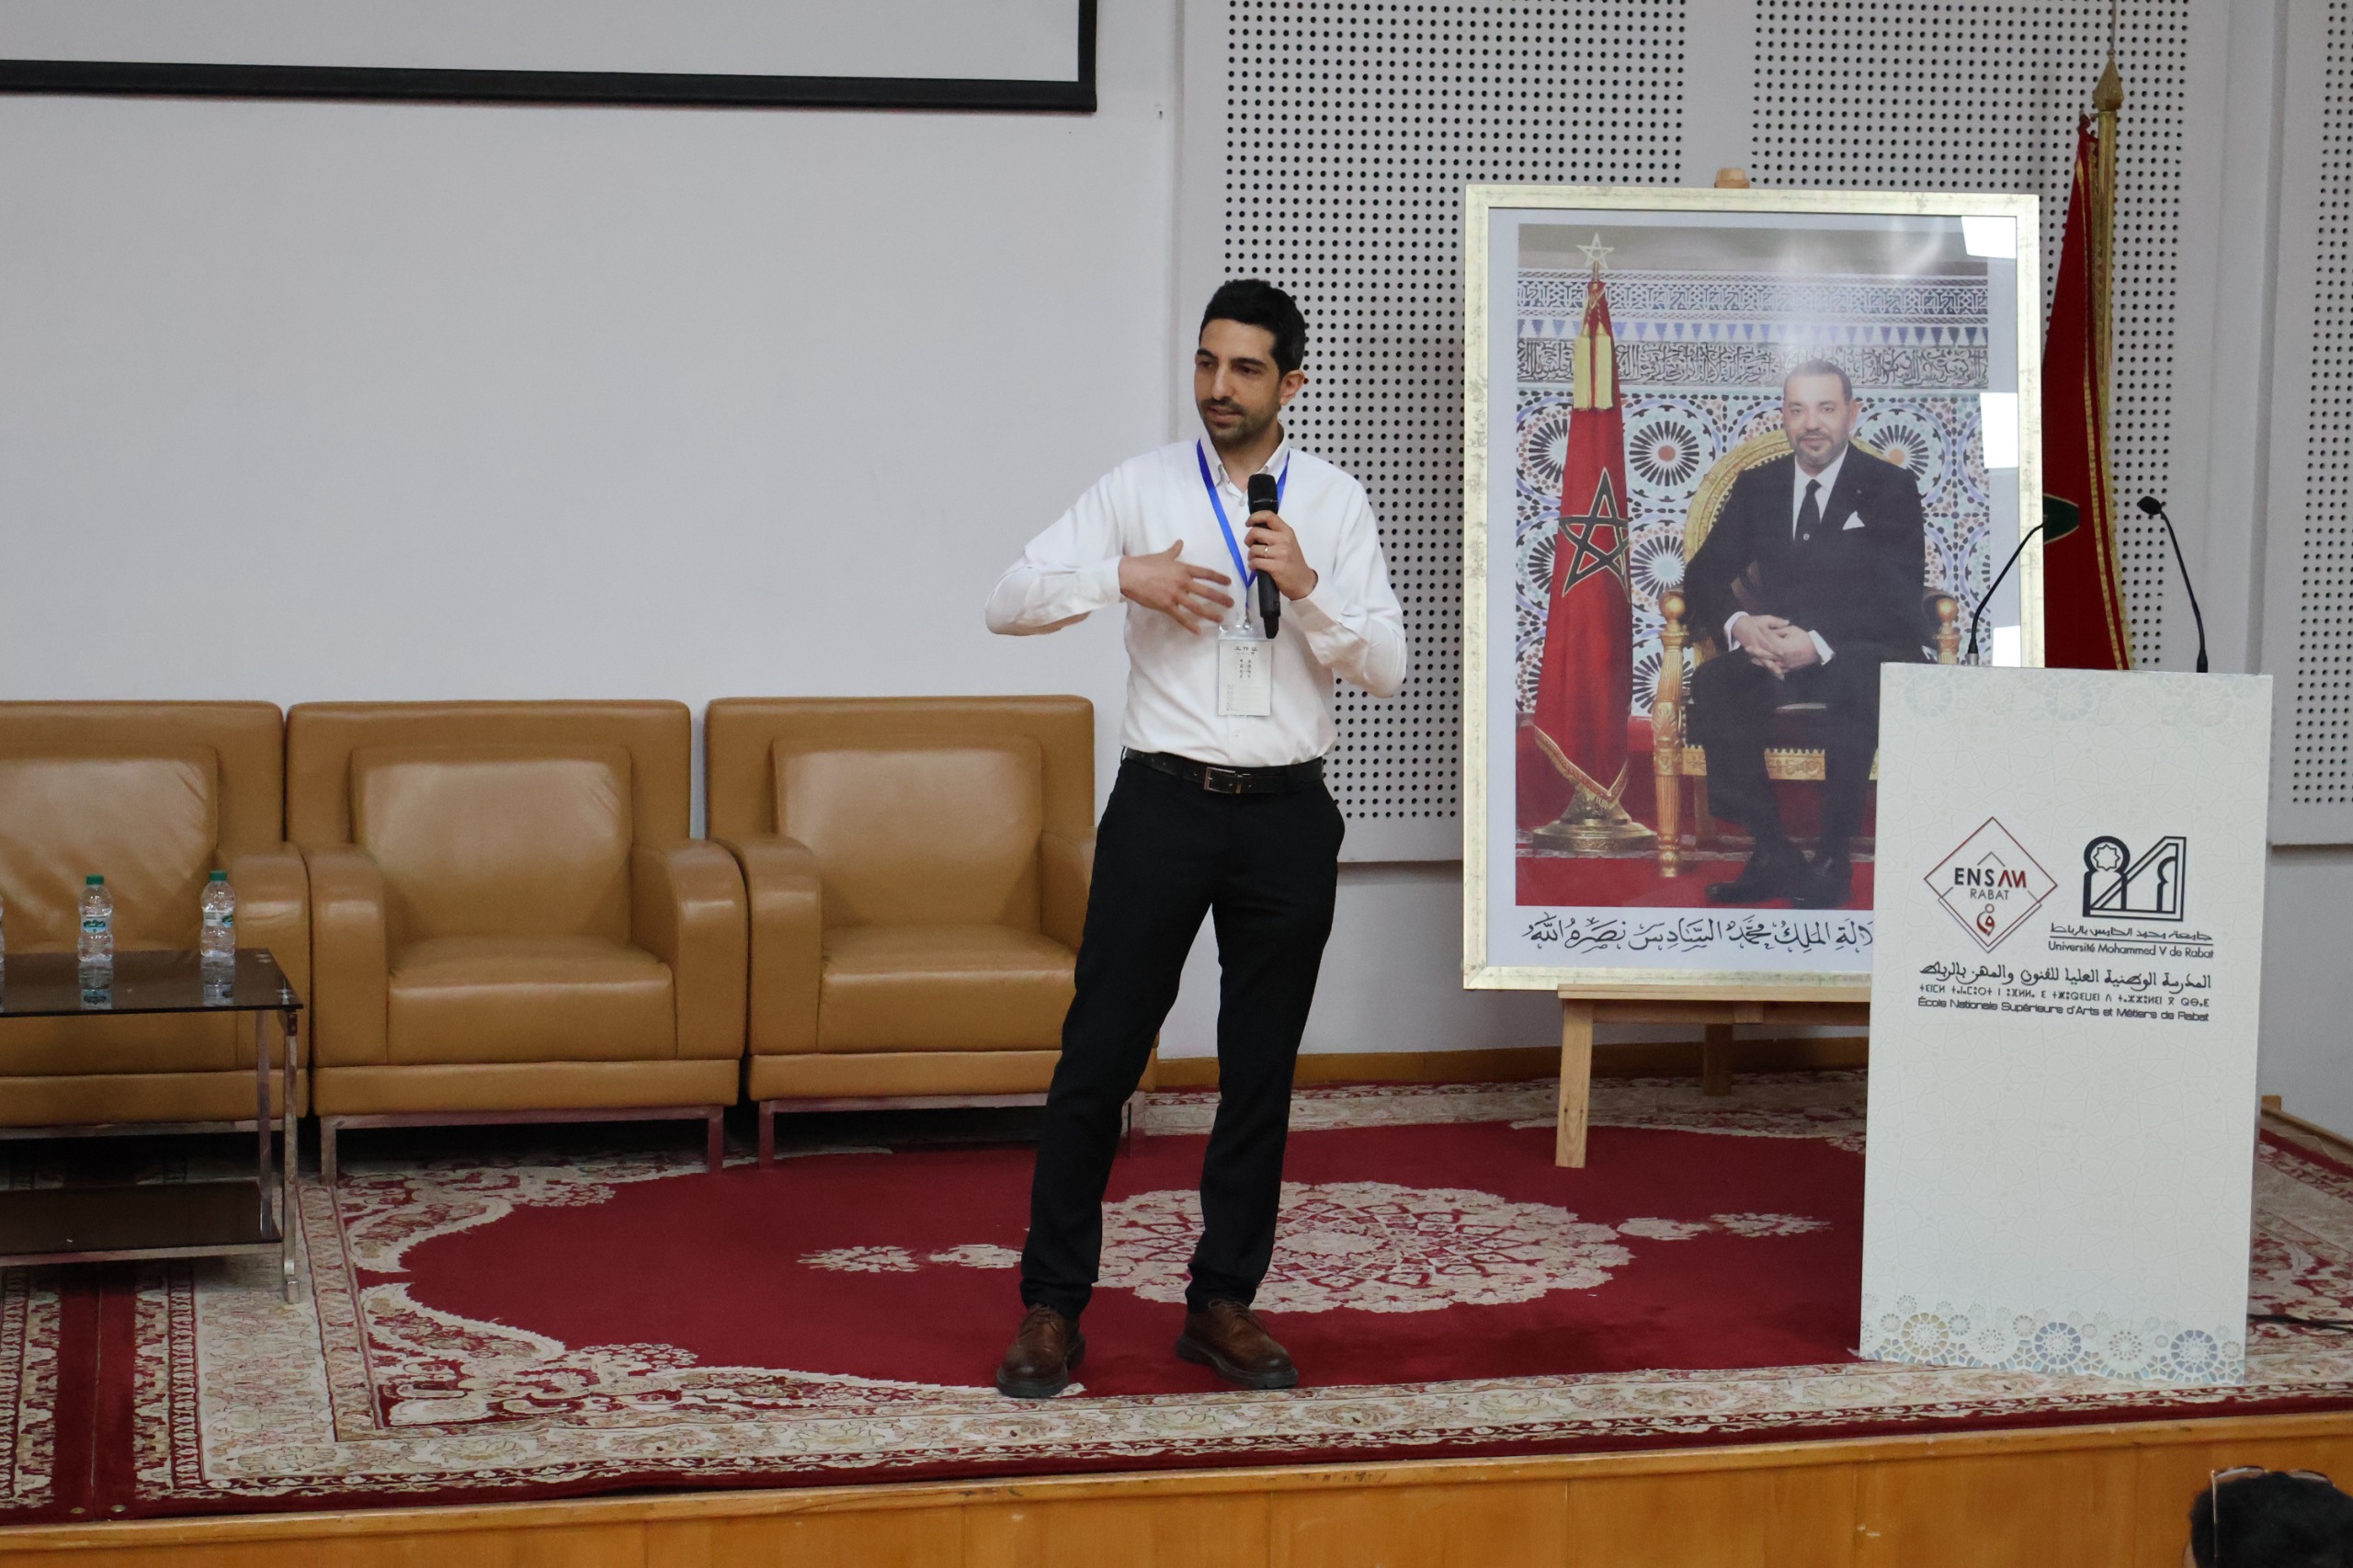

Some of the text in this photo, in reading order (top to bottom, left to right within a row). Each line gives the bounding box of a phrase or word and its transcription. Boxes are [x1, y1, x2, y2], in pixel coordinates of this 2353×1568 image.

[1970, 888, 2009, 901] RABAT
[2048, 940, 2214, 959] Université Mohammed V de Rabat
[1919, 960, 2211, 994] المدرسة الوطنية العليا للفنون والمهن بالرباط
[1918, 995, 2210, 1022] École Nationale Supérieure d'Arts et Métiers de Rabat
